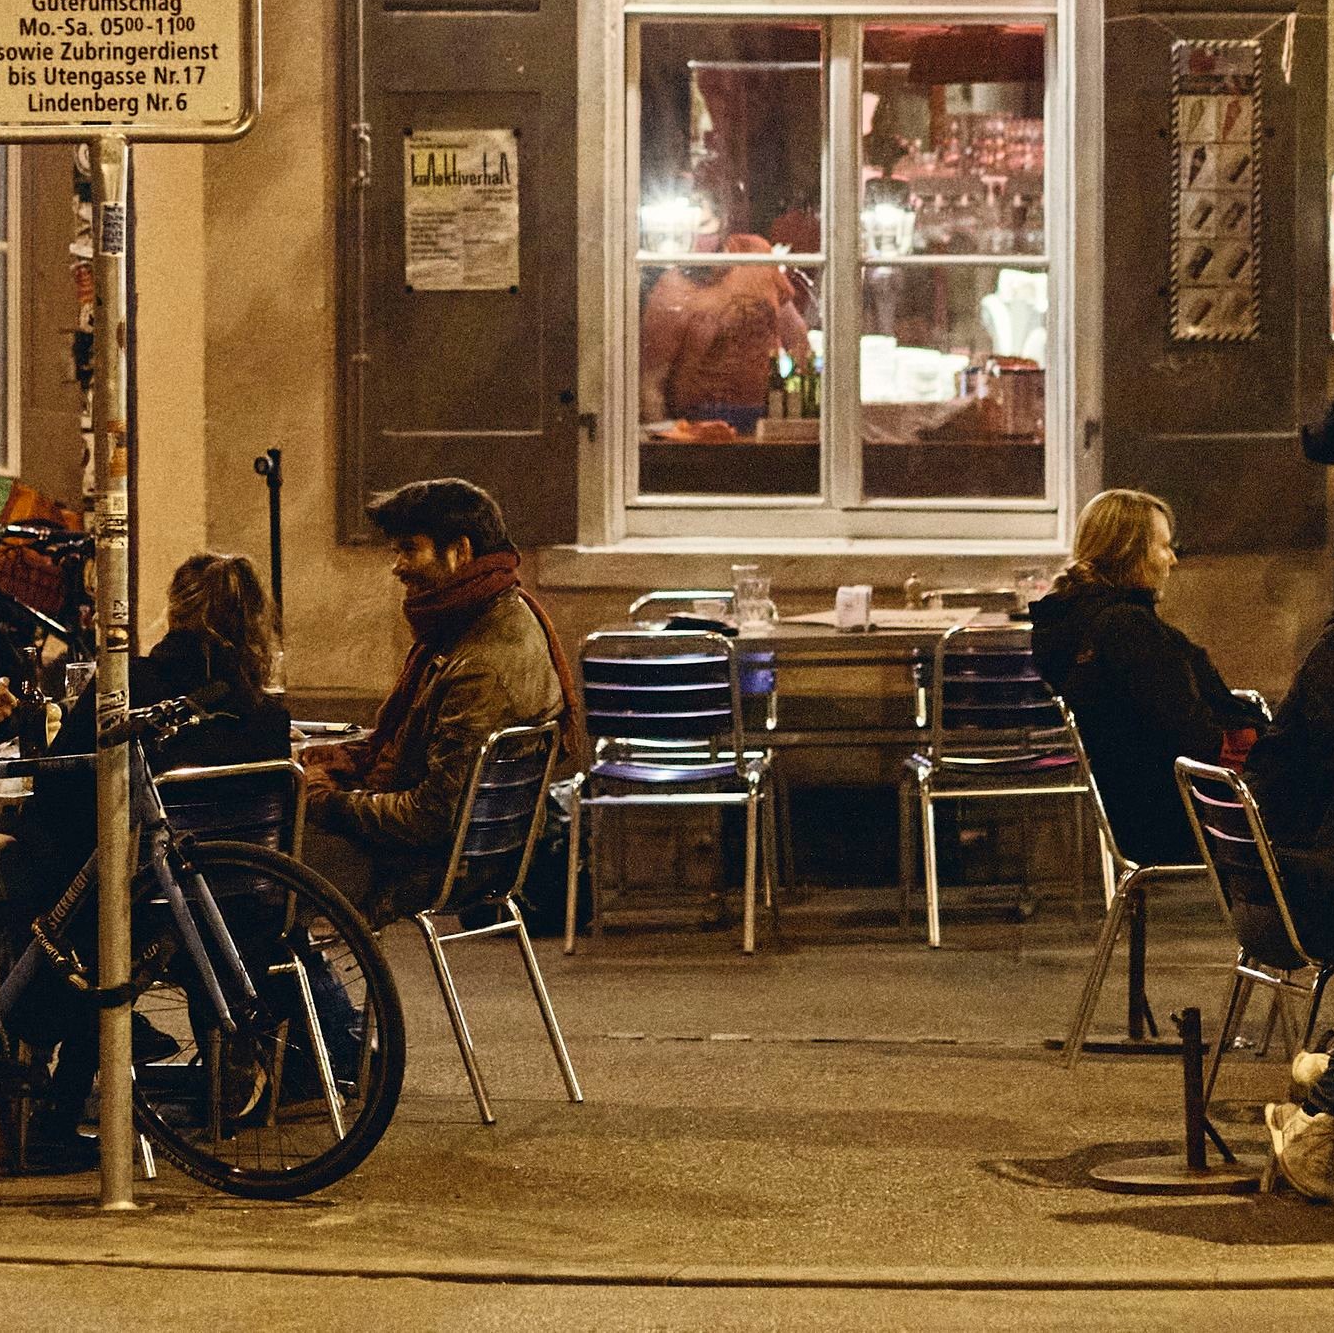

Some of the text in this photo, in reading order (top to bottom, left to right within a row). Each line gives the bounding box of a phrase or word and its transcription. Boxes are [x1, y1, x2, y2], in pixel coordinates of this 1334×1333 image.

[19, 17, 93, 37] Mo.-Sa.
[60, 40, 219, 66] Zubringerdienst
[8, 65, 37, 86] bis
[43, 66, 147, 91] Utengasse
[28, 92, 139, 117] Lindenberg
